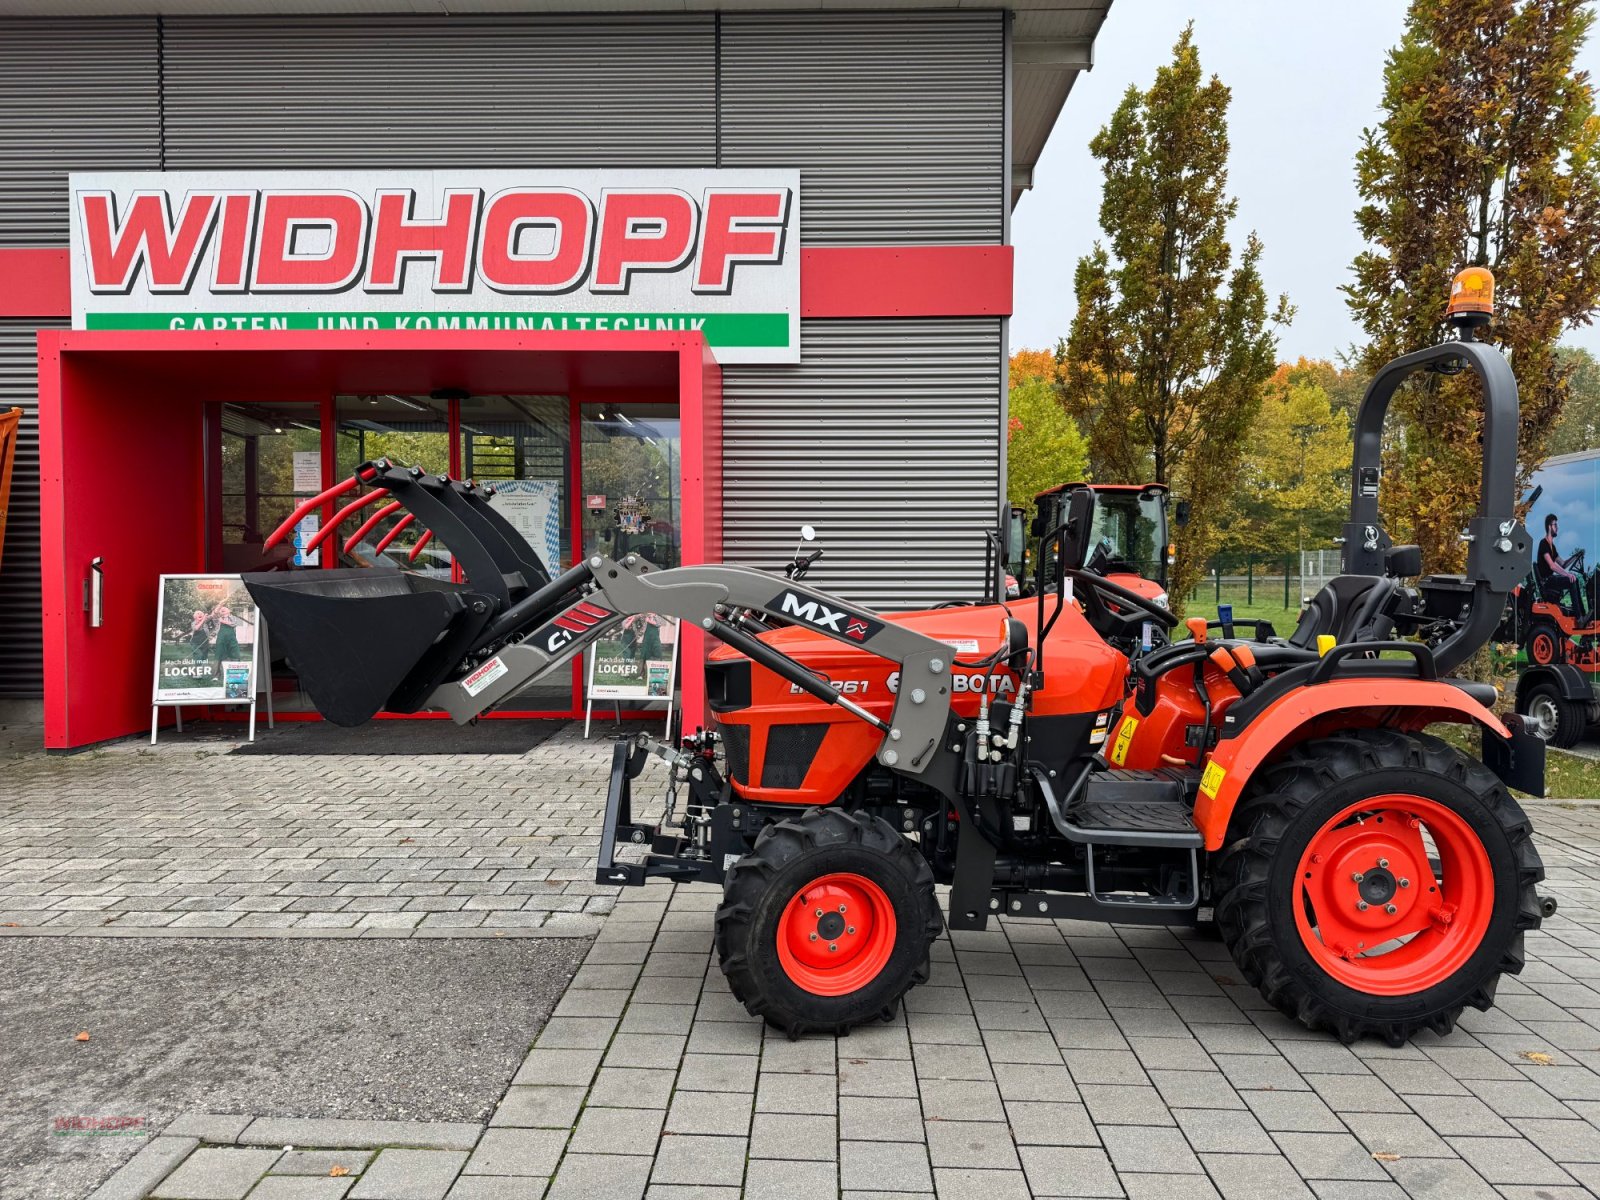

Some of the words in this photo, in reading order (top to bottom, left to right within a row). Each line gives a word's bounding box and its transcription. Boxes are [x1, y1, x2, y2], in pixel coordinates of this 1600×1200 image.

[76, 186, 793, 296] WIDHOPF
[781, 592, 848, 633] MX
[548, 629, 572, 652] C1
[164, 666, 212, 677] LOCKER
[598, 664, 638, 674] LOCKER
